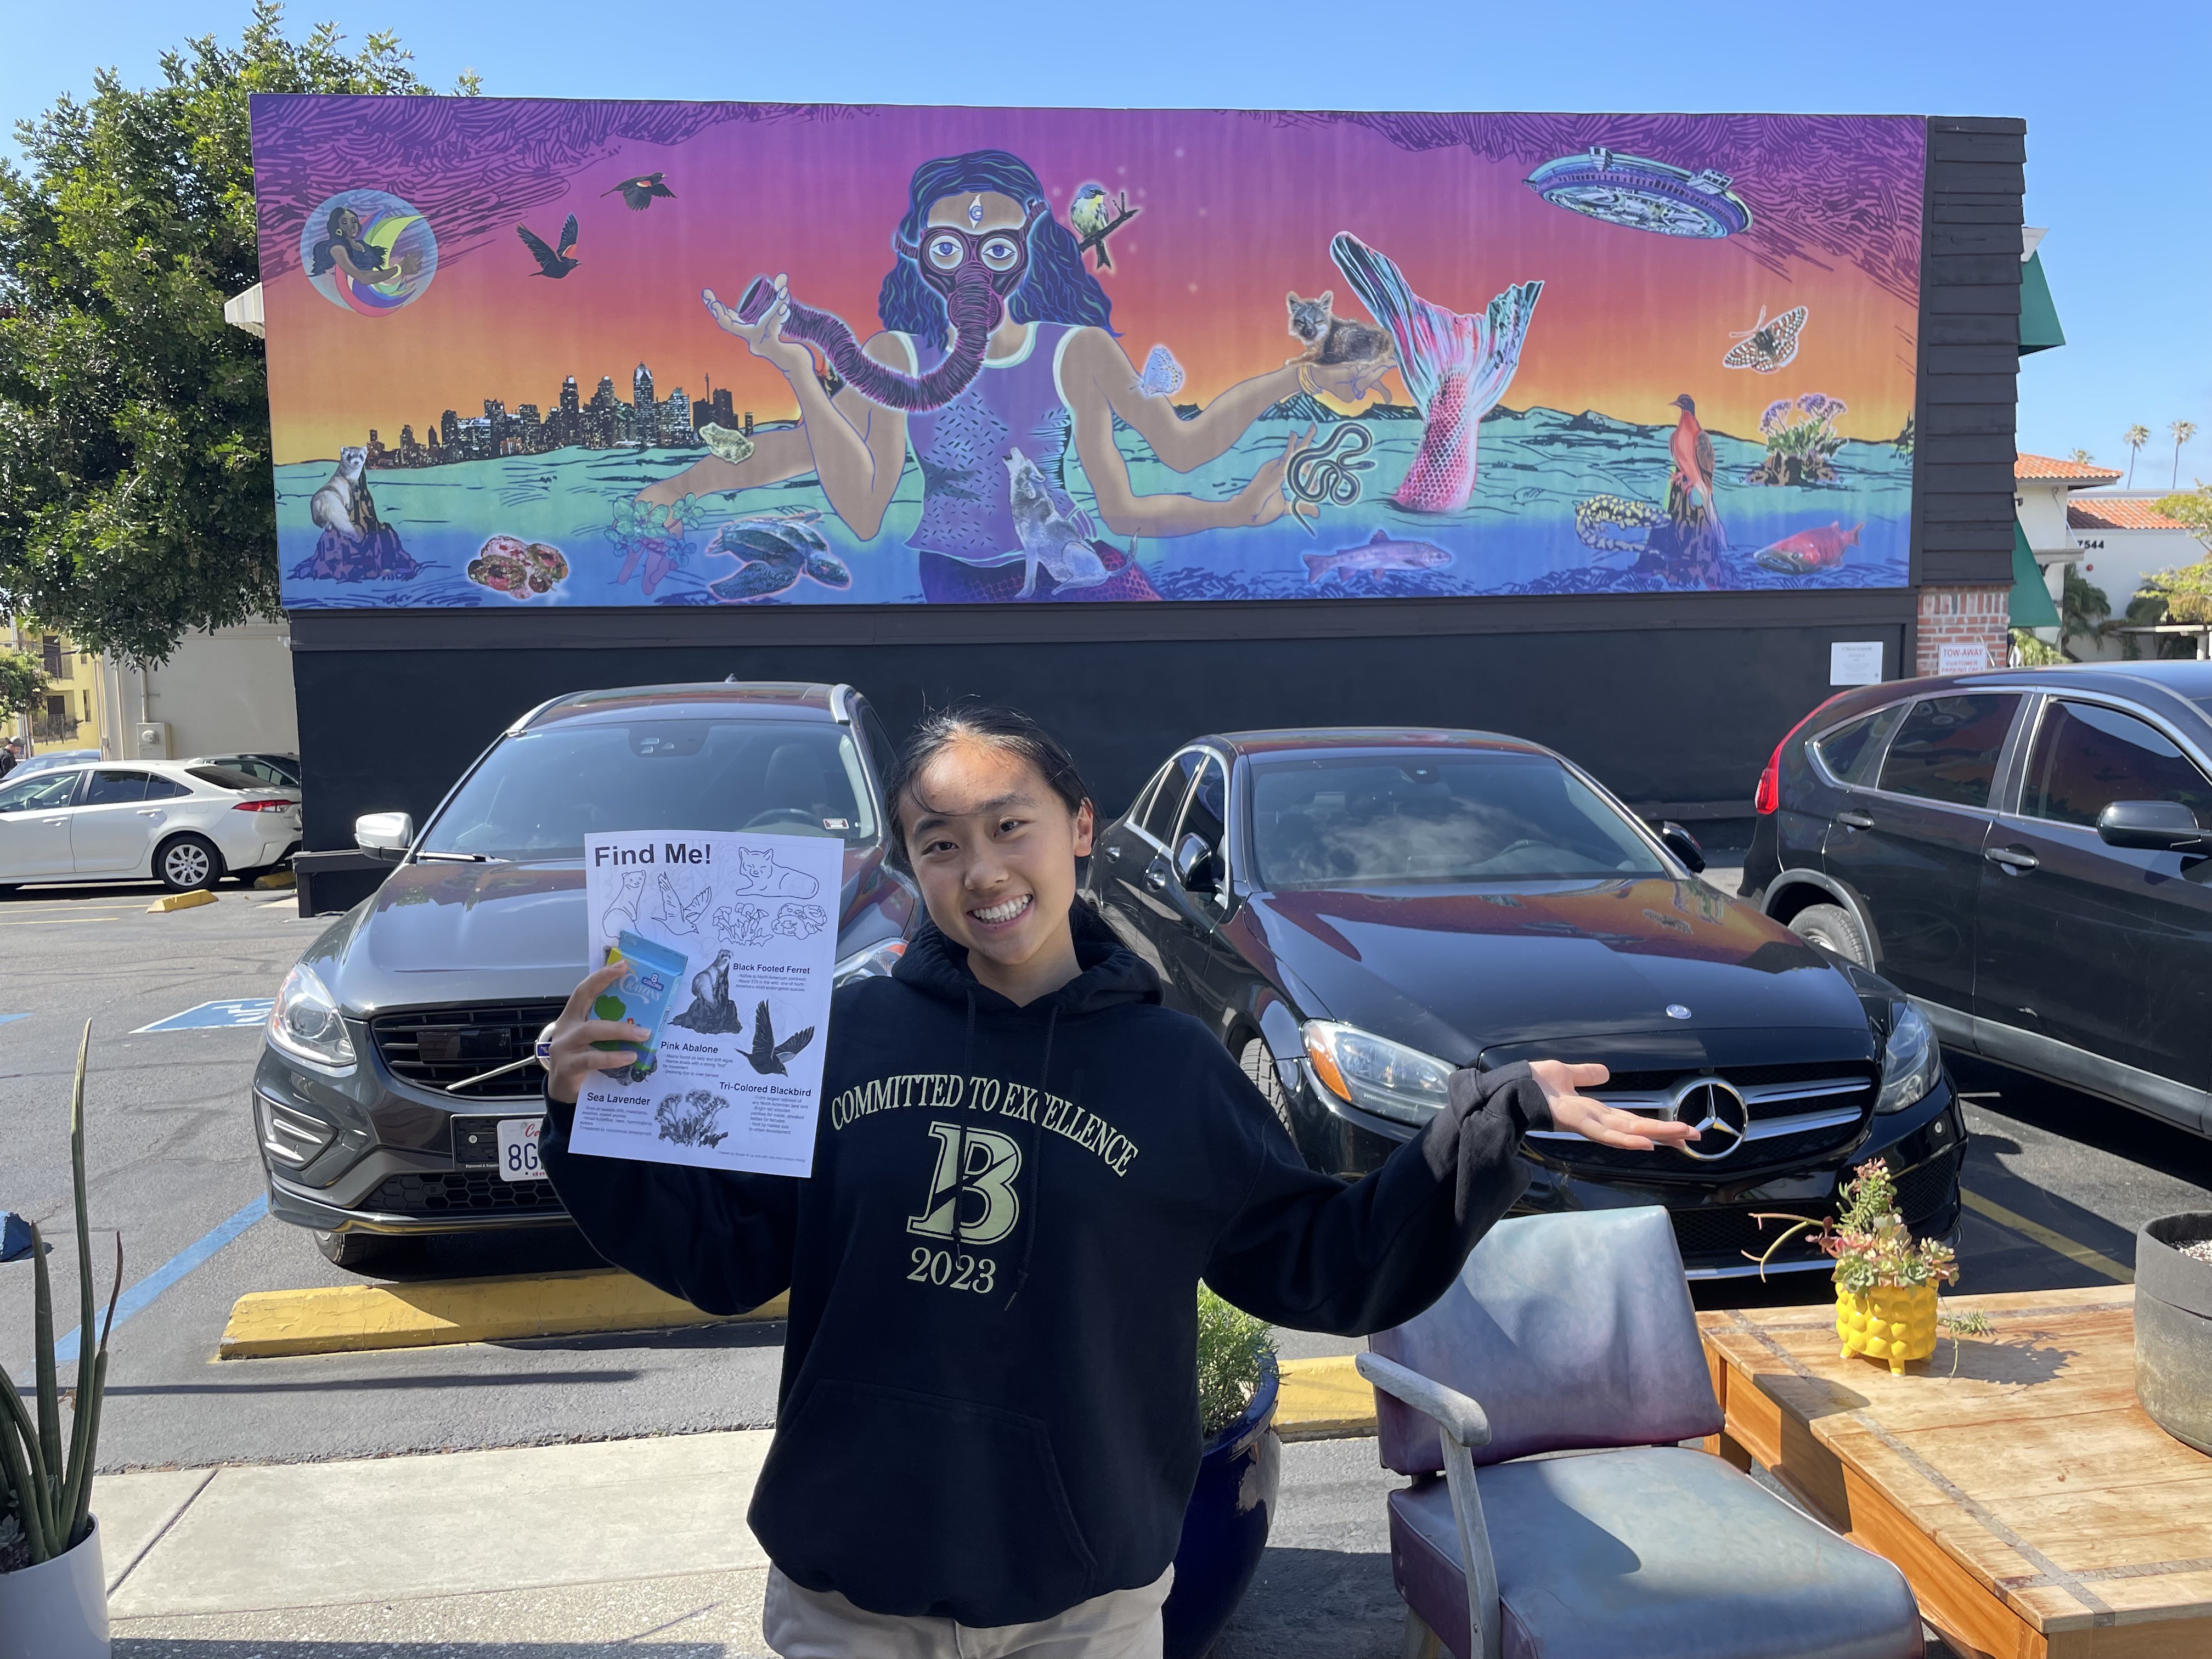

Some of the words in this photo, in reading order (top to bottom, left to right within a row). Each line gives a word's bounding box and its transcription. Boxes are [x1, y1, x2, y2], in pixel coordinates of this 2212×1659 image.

[2077, 540, 2104, 549] 7544
[595, 843, 654, 867] Find
[665, 843, 710, 864] Me!
[757, 964, 785, 973] Footed
[787, 966, 810, 974] Ferret
[643, 979, 662, 990] COLORS
[651, 974, 658, 983] 8
[661, 1041, 680, 1050] Pink
[682, 1043, 718, 1053] Abalone
[720, 1081, 768, 1093] Tri-Colored
[770, 1086, 811, 1097] Blackbird
[587, 1092, 604, 1102] Sea
[607, 1093, 651, 1105] Lavender
[831, 1074, 964, 1131] COMMITTED
[969, 1076, 1001, 1112] TO
[525, 1123, 541, 1137] Ca
[508, 1143, 540, 1171] 8G
[906, 1121, 1023, 1245] B
[907, 1248, 996, 1294] 2023
